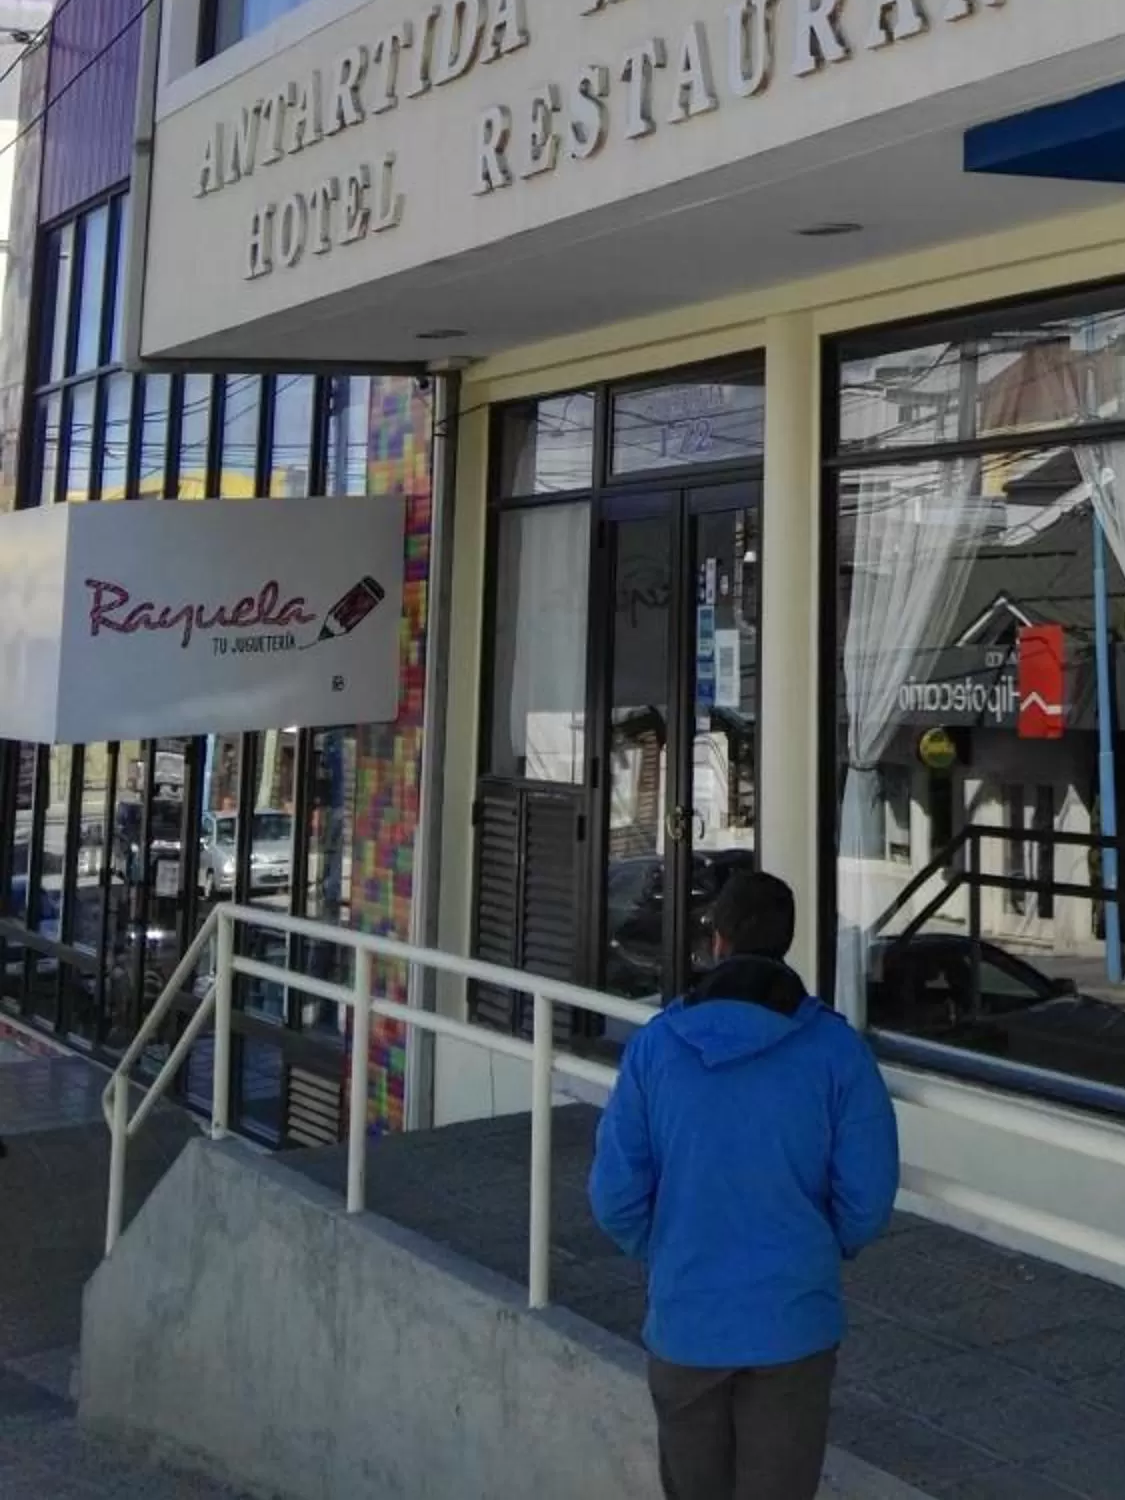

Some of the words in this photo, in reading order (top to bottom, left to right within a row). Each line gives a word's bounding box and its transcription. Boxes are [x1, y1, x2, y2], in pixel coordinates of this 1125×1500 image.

[243, 152, 404, 280] HOTEL
[85, 579, 317, 649] Rayuela
[212, 637, 228, 657] TU
